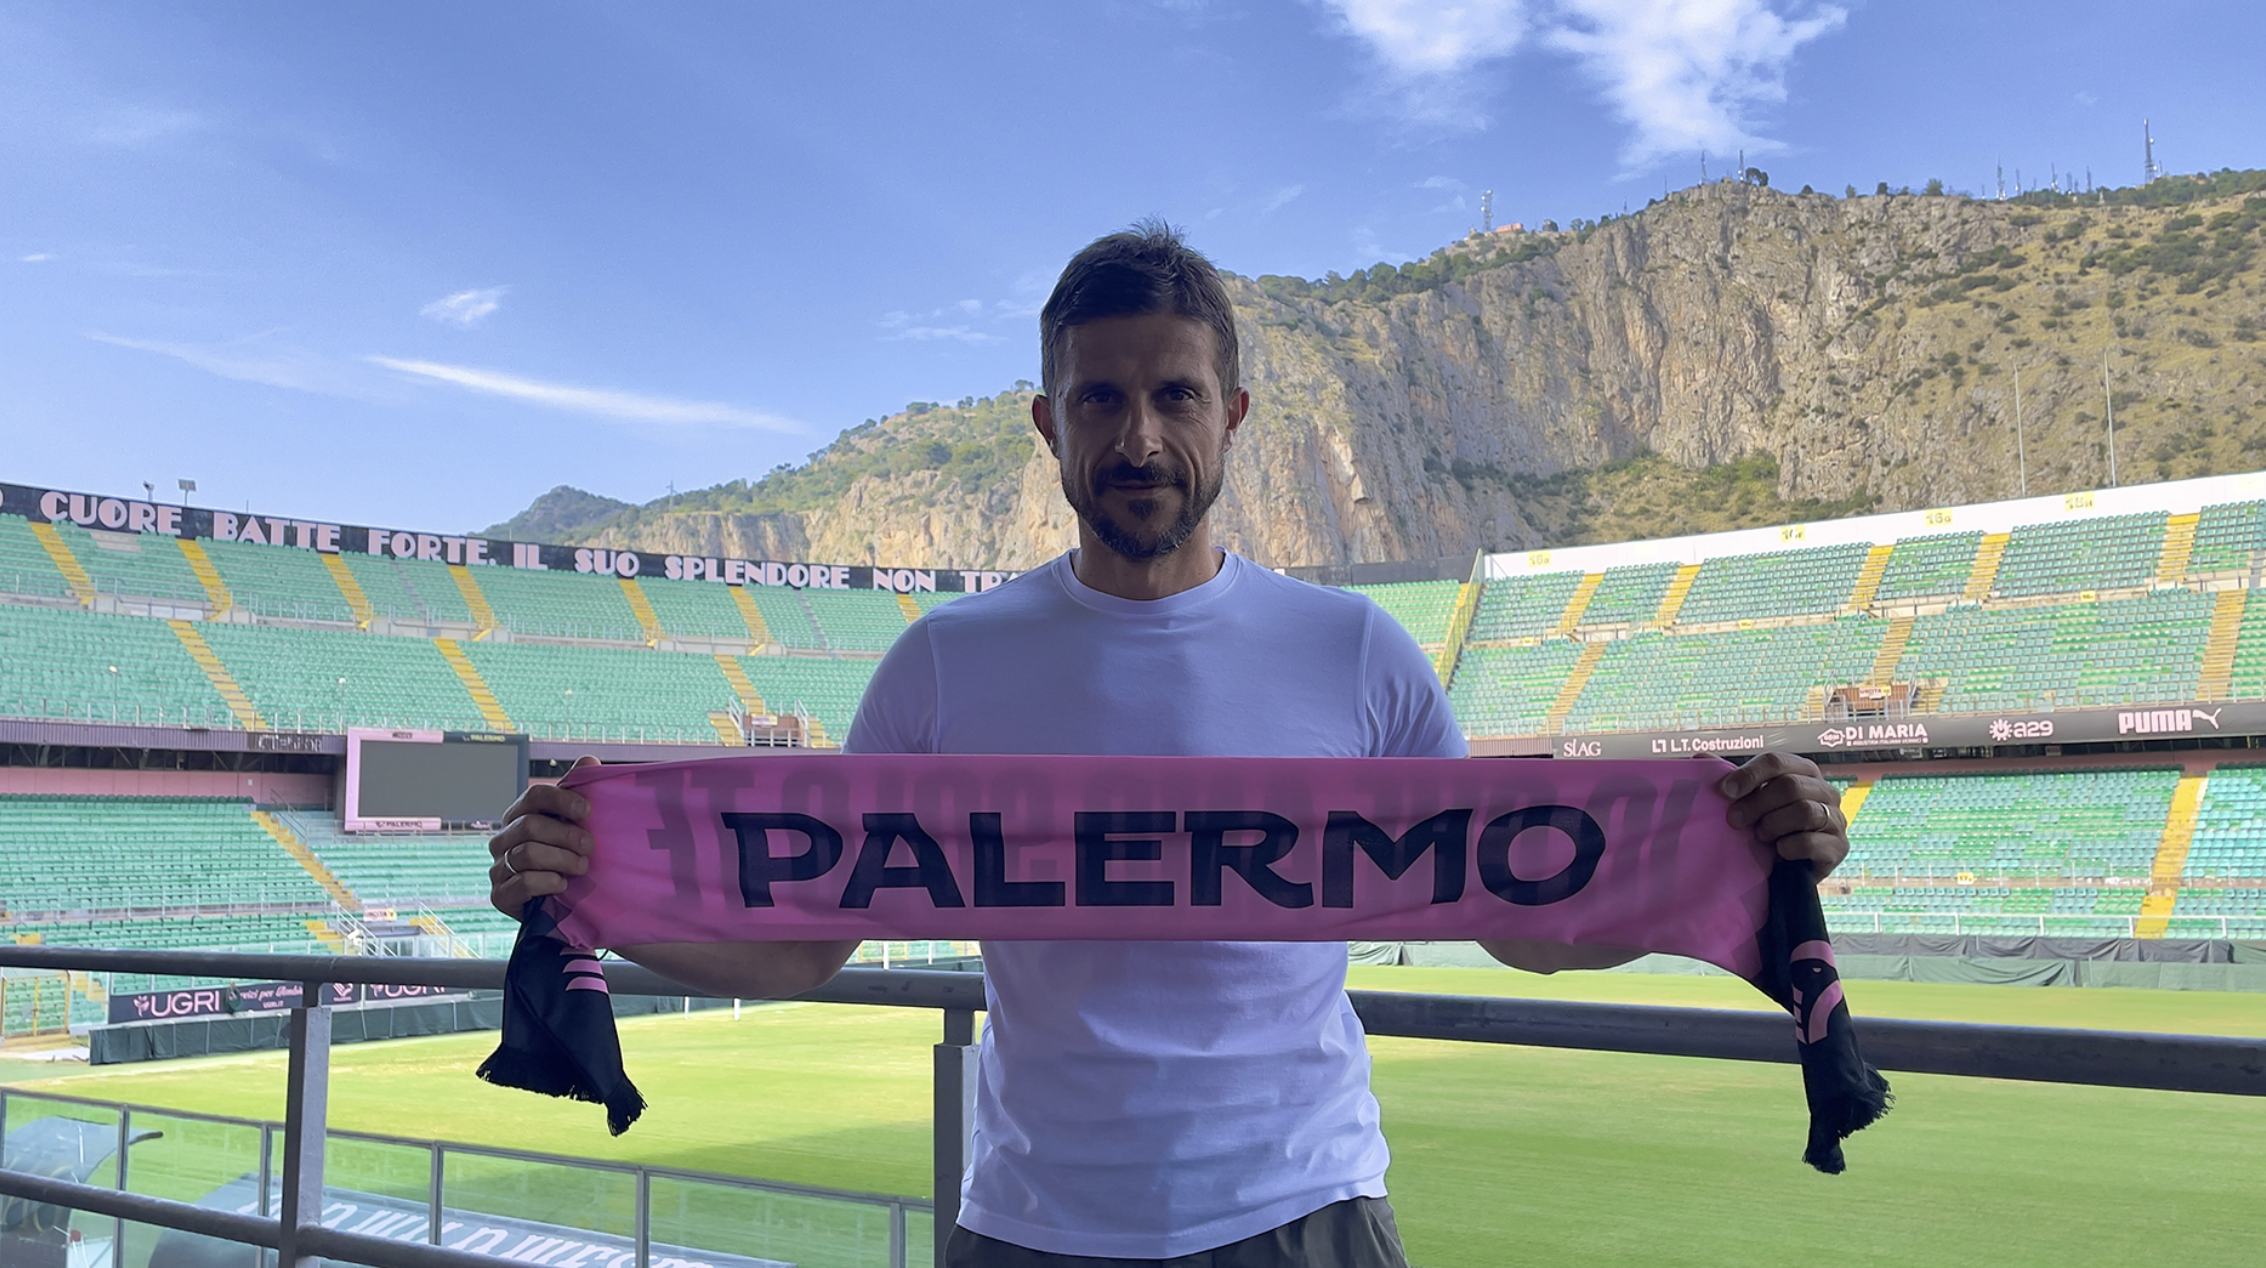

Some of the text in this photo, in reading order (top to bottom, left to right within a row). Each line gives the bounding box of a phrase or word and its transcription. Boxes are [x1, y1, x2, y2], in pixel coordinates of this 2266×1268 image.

[40, 491, 1019, 594] CUORE BATTE FORTE. IL SUO SPLENDORE NON TR
[1845, 726, 1864, 740] DI
[1868, 723, 1927, 739] MARIA
[2118, 709, 2193, 734] PUMA
[720, 806, 1608, 910] PALERMO
[151, 990, 220, 1017] UGRI
